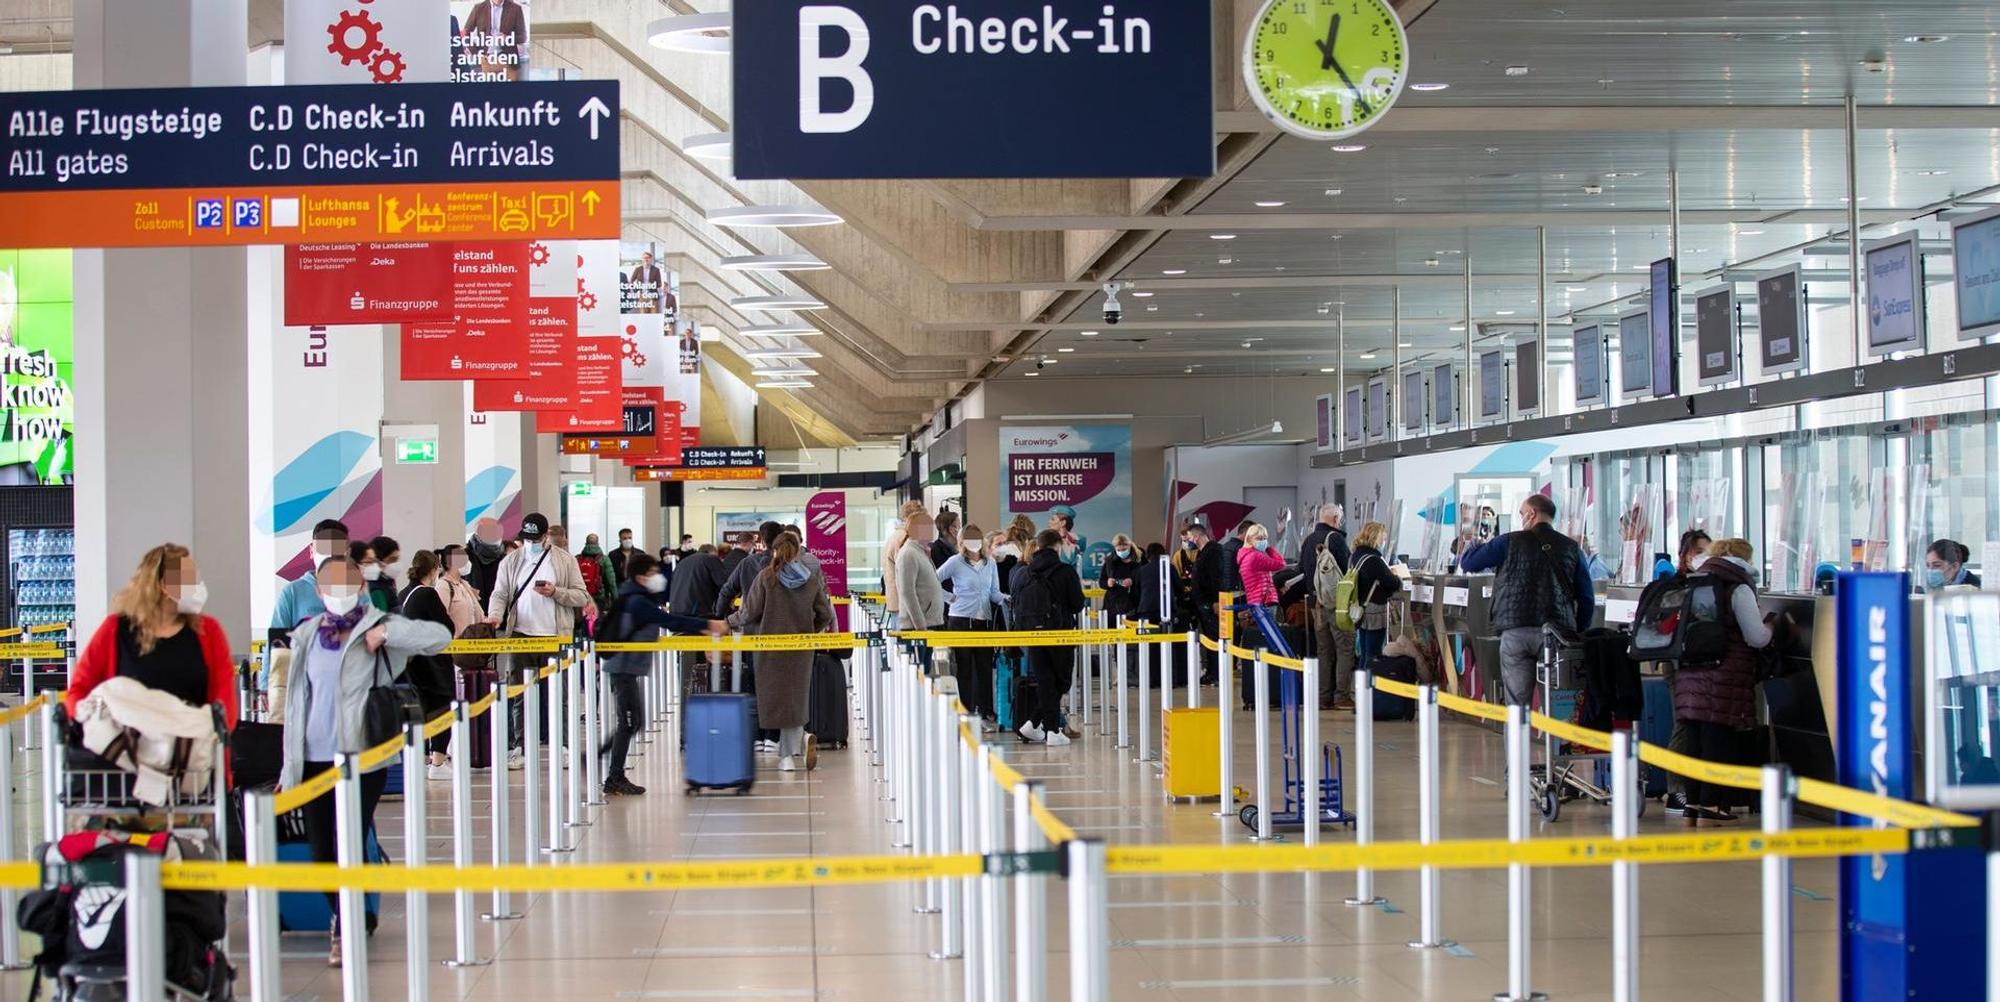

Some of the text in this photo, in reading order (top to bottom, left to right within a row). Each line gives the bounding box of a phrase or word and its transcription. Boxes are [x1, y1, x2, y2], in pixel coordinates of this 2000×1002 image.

[1294, 3, 1306, 14] 11
[1352, 3, 1359, 14] 1
[912, 5, 1151, 54] Check-in
[1272, 23, 1287, 34] 10
[1372, 25, 1379, 36] 2
[457, 50, 518, 65] auf den
[1267, 50, 1274, 61] 9
[1381, 51, 1388, 63] 3
[800, 6, 874, 133] B
[1276, 77, 1284, 89] 8
[1295, 100, 1302, 111] 7
[250, 103, 425, 131] C.D Check-in
[450, 100, 560, 128] Ankunft
[1324, 107, 1332, 119] 6
[9, 107, 222, 140] Alle Flugsteige
[250, 143, 418, 171] C.D Check-in
[450, 140, 554, 167] Arrivals
[9, 150, 129, 183] All gates
[135, 202, 159, 214] Zoll
[309, 199, 370, 212] Lufthansa
[501, 195, 527, 209] Taxi
[135, 218, 185, 230] Customs
[309, 215, 356, 229] Lounges
[331, 244, 356, 252] Leasing
[372, 258, 395, 266] Deka
[459, 265, 479, 273] uns
[480, 263, 518, 273] zählen.
[370, 299, 438, 312] Finanzgruppe
[466, 361, 518, 370] Finanzgruppe
[12, 409, 64, 442] how
[1014, 437, 1058, 447] Eurowings
[1014, 458, 1097, 470] IHR FERNWEH
[1014, 474, 1083, 486] IST UNSERE
[1014, 489, 1071, 502] MISSION.
